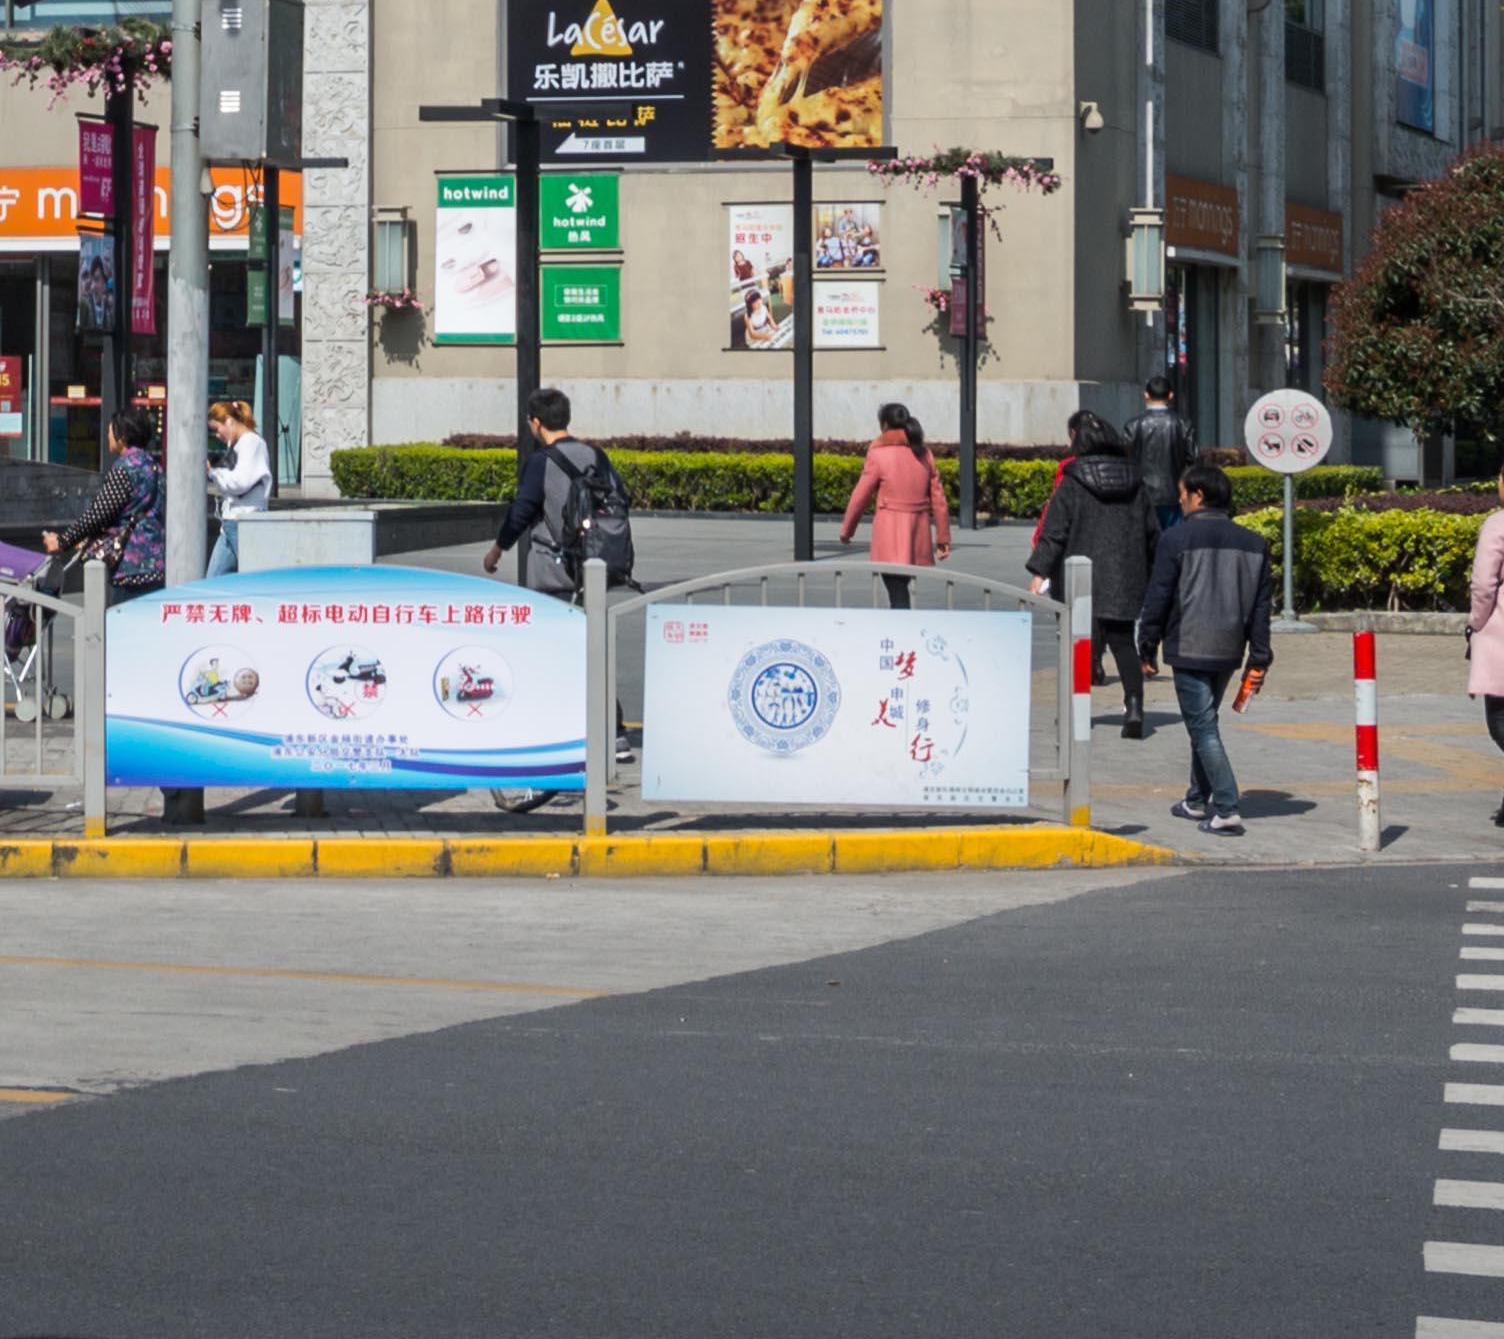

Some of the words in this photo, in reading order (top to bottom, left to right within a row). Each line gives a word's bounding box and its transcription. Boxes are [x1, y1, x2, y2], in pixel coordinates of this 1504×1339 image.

[443, 186, 509, 200] hotwind
[553, 215, 607, 228] hotwind
[162, 602, 534, 626] 严禁无牌、超标电动自行车上路行驶
